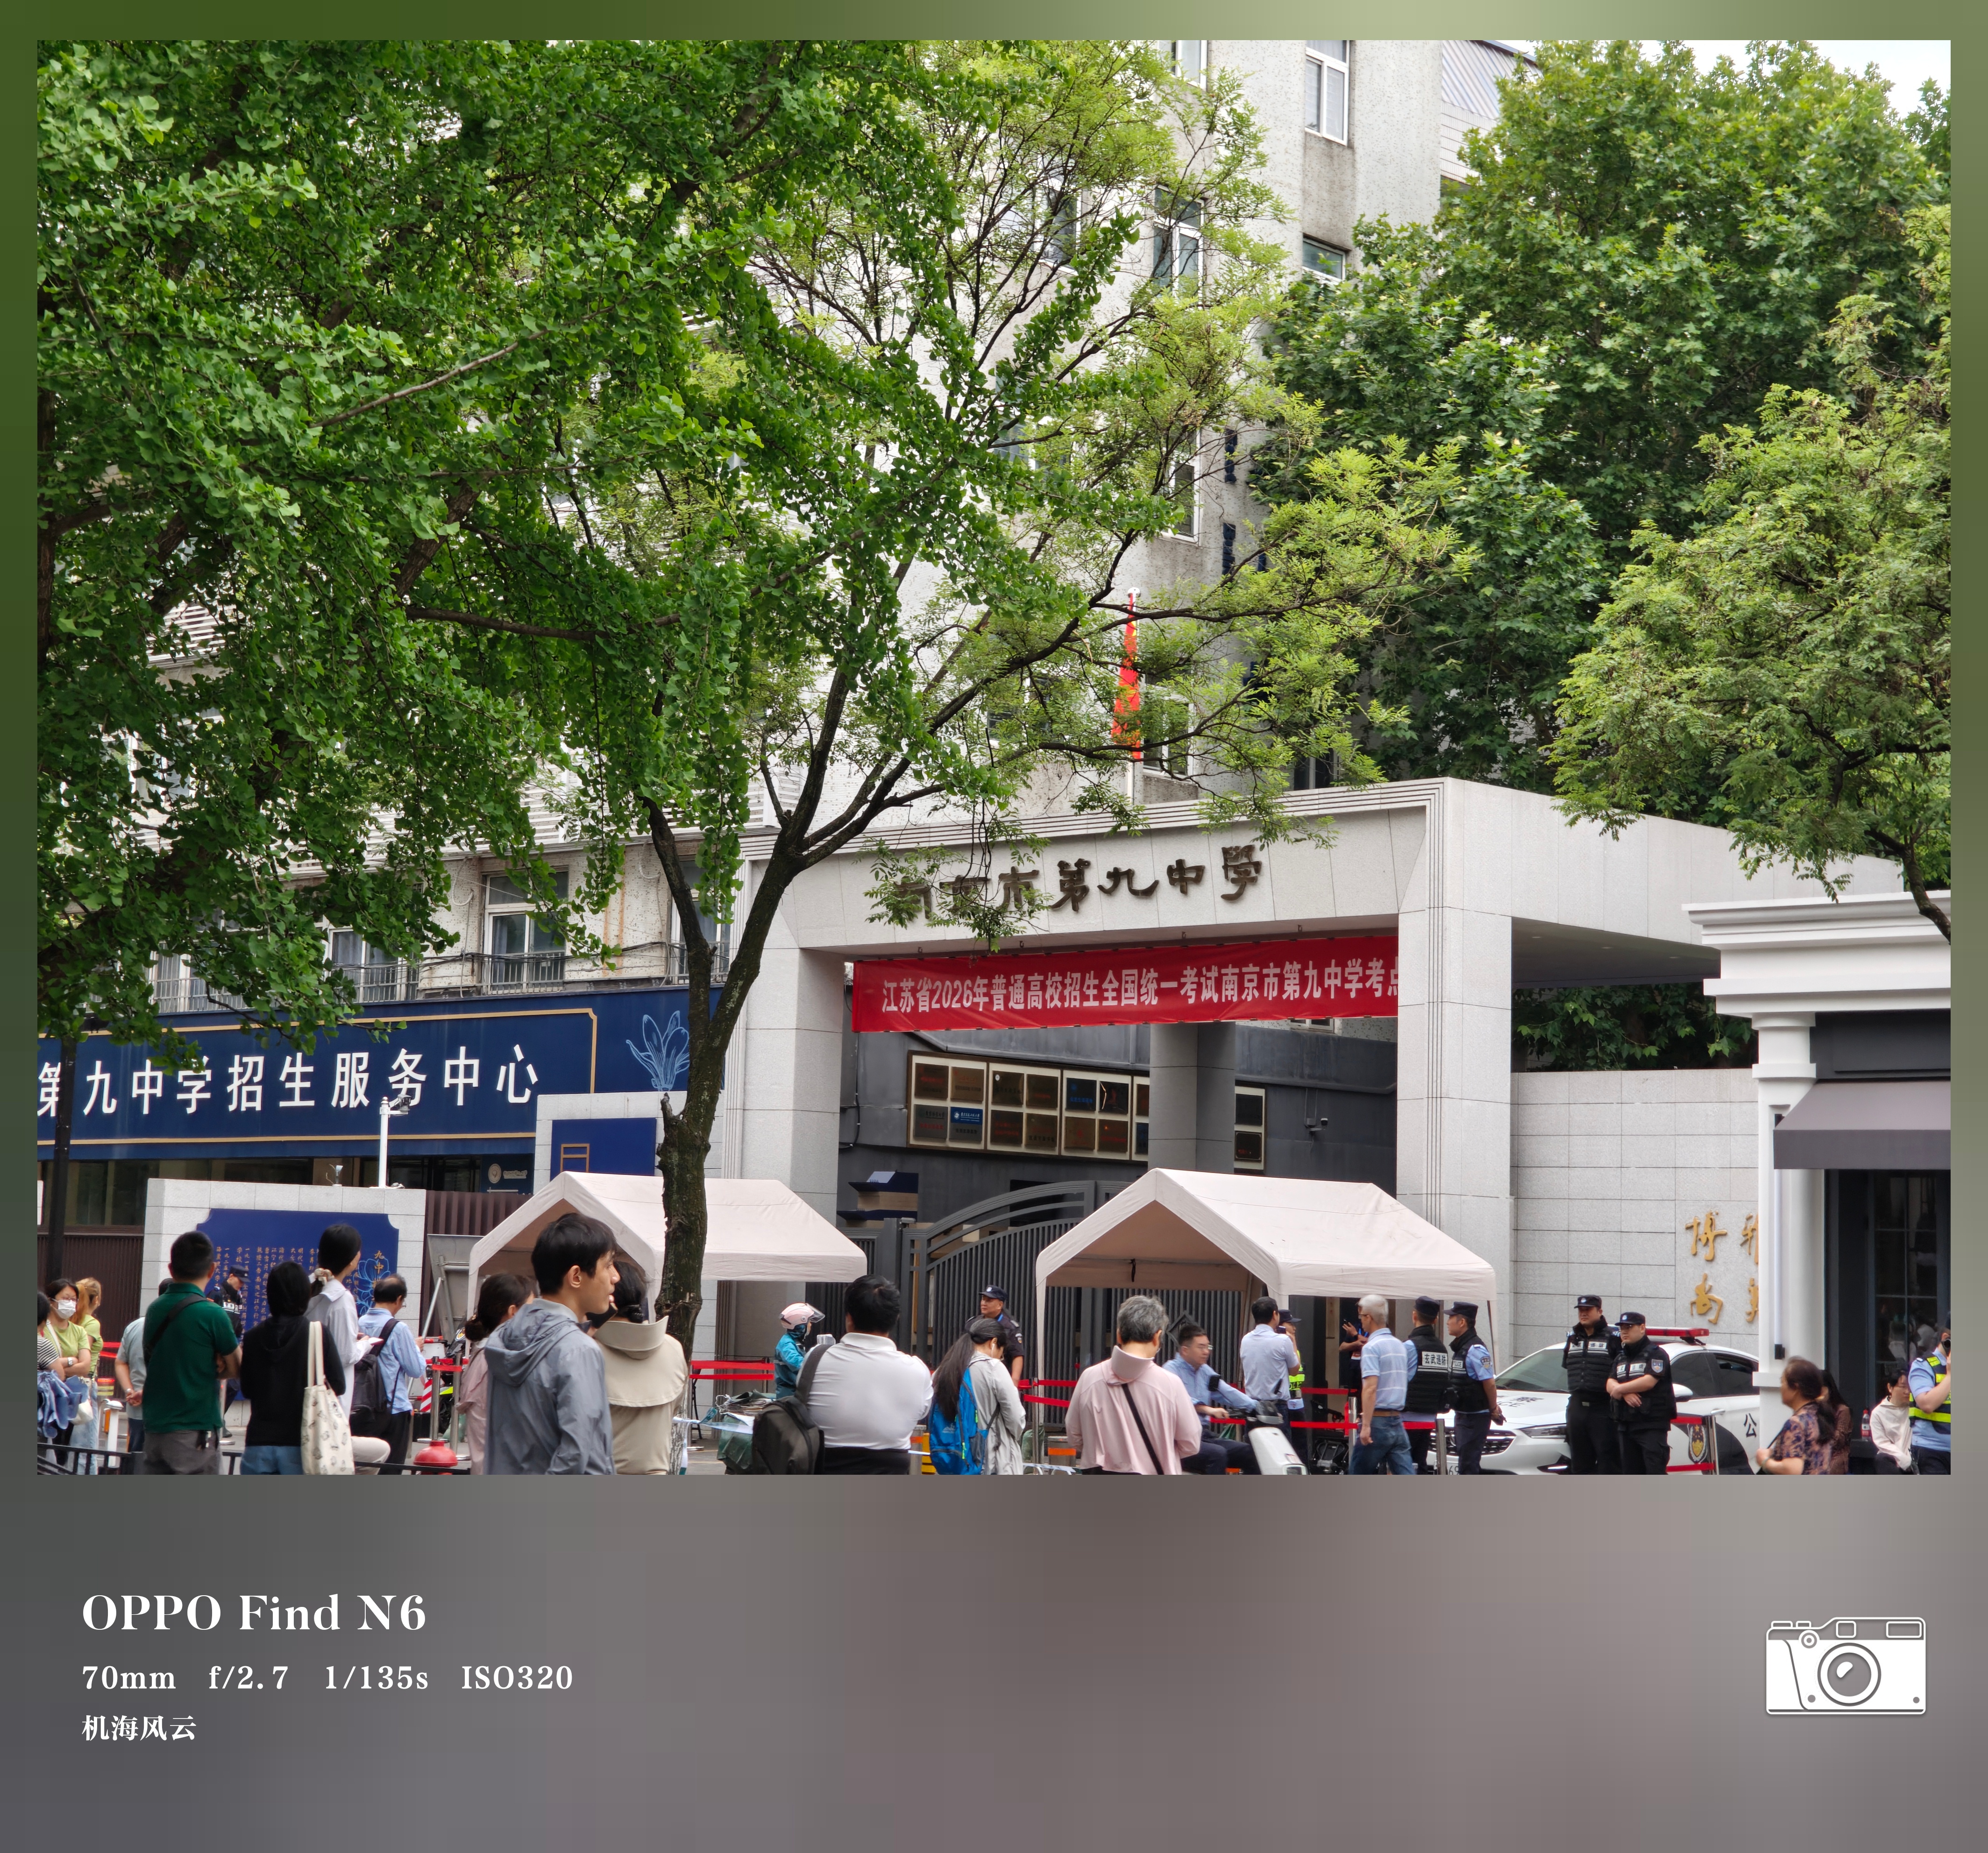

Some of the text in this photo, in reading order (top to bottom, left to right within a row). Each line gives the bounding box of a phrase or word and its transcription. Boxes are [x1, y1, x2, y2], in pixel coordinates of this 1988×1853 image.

[37, 1044, 538, 1117] 第九中学招生服务中心
[1743, 1413, 1757, 1438] 公
